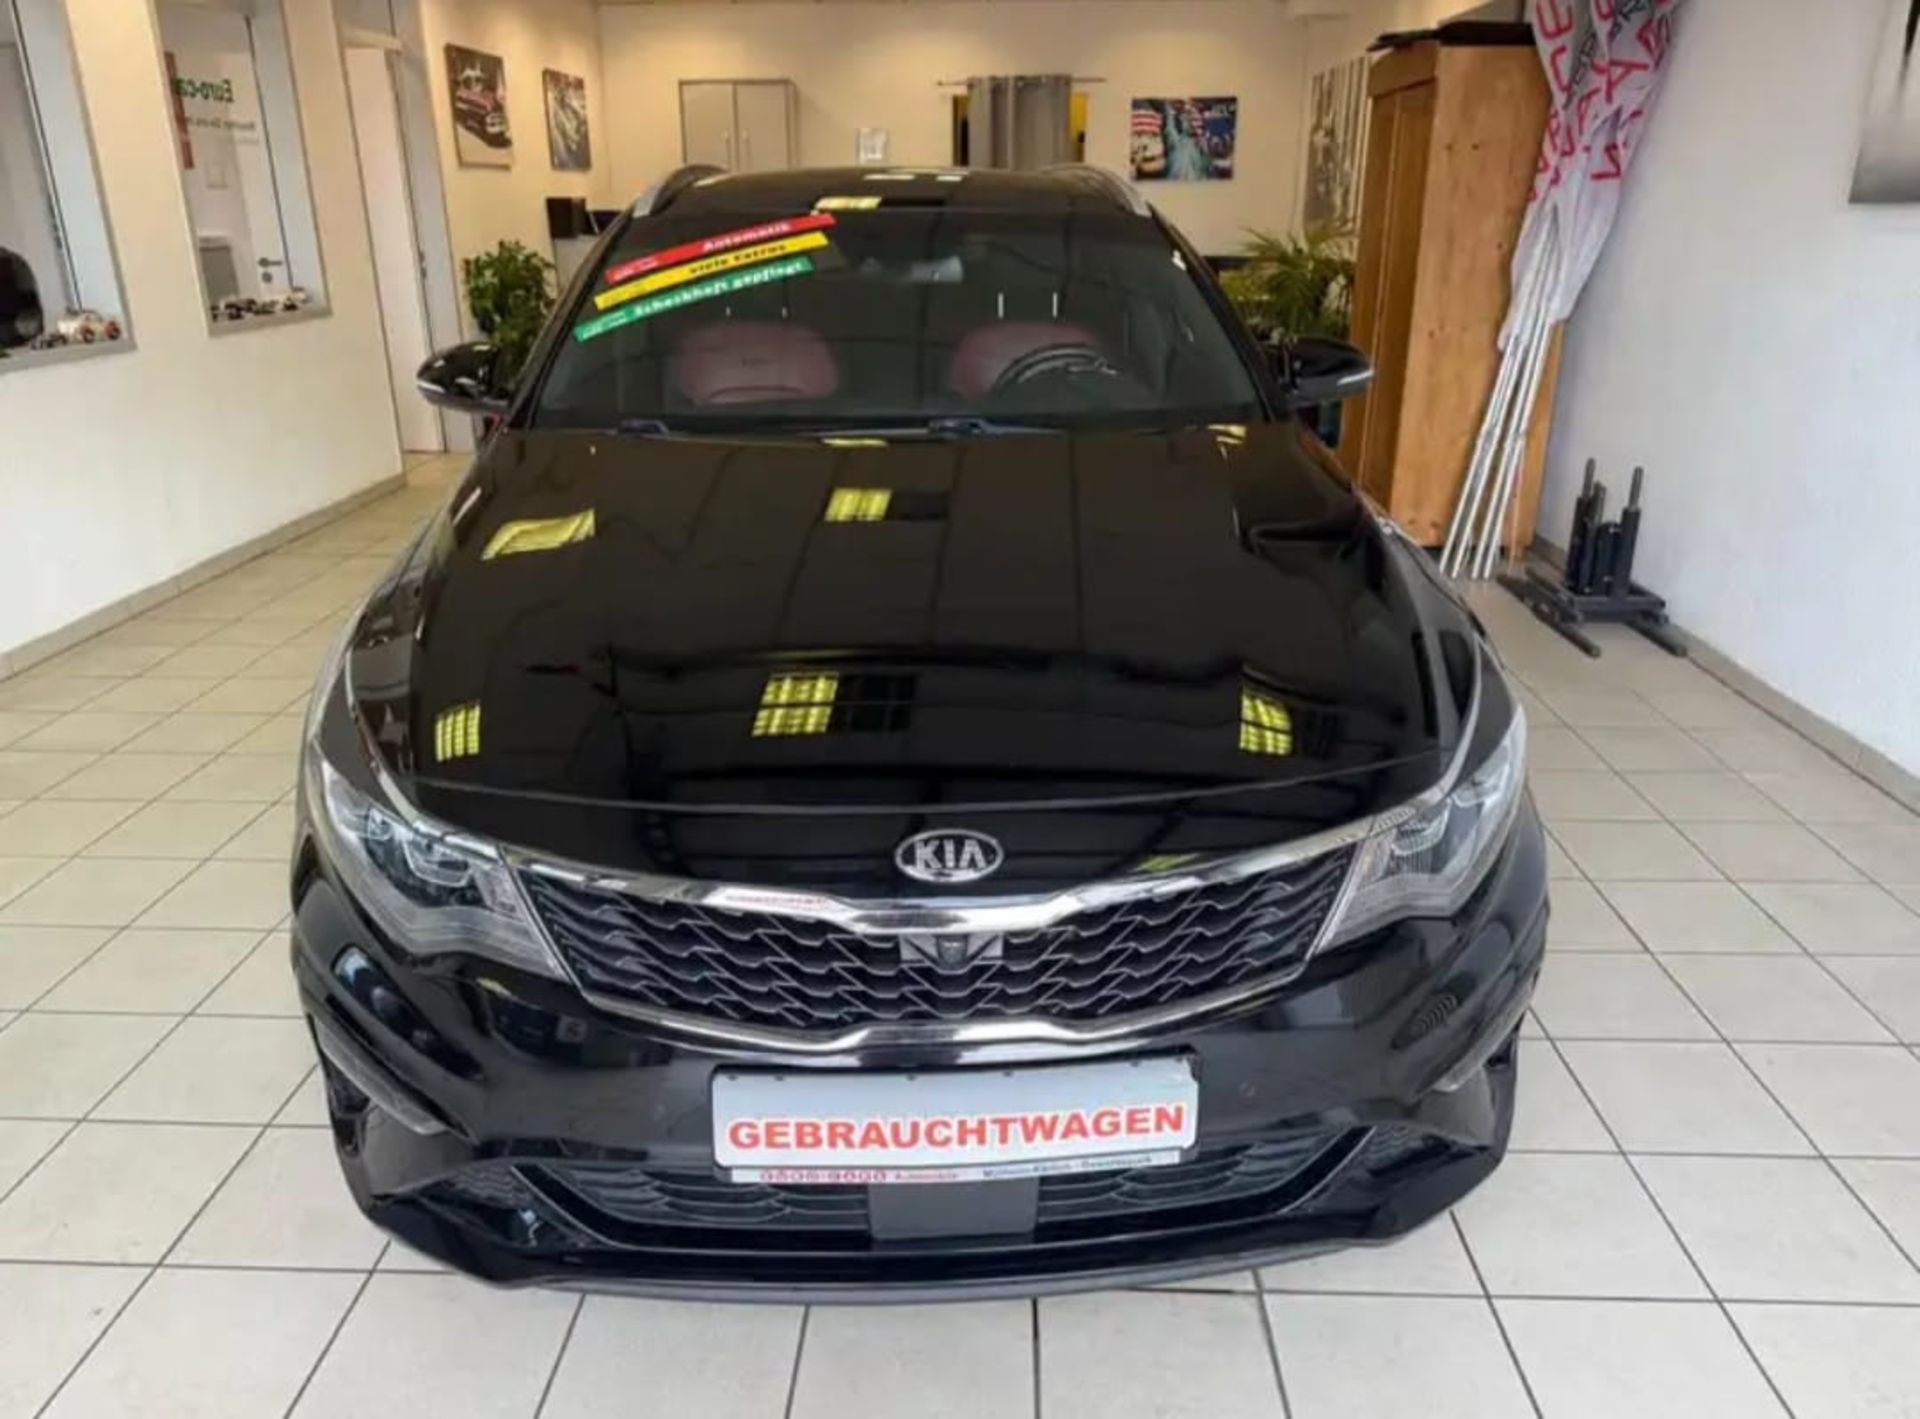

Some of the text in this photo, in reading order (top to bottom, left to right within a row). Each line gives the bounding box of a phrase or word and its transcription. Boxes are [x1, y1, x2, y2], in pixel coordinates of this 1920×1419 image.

[703, 222, 791, 252] Automatik
[913, 838, 987, 870] KIA
[728, 1105, 1184, 1150] GEBRAUCHTWAGEN
